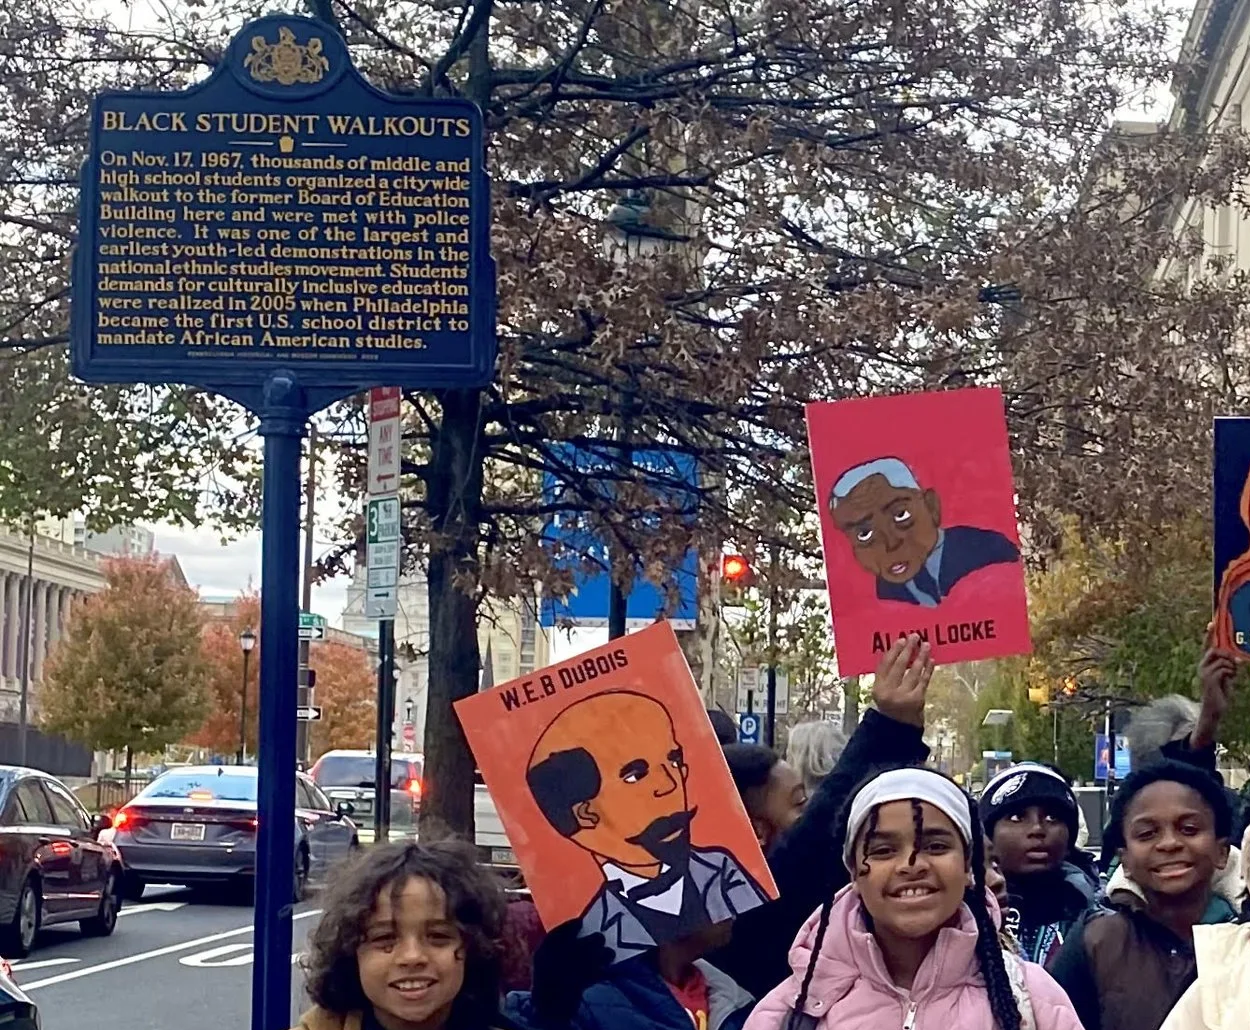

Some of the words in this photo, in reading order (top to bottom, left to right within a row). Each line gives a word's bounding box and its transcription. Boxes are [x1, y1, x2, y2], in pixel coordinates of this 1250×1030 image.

[102, 111, 188, 131] BLACK
[195, 113, 319, 134] STUDENT
[327, 115, 470, 137] WALKOUTS
[101, 151, 126, 166] On
[132, 151, 168, 167] Nov.
[251, 154, 344, 170] thousands
[348, 155, 368, 170] of
[370, 156, 431, 172] middle
[436, 157, 470, 172] and
[100, 169, 140, 188] high
[144, 170, 200, 186] school
[204, 171, 281, 187] students
[286, 173, 376, 192] organized
[379, 178, 388, 189] a
[392, 175, 470, 193] citywide
[101, 188, 169, 203] walkout
[174, 190, 194, 203] to
[197, 189, 226, 204] the
[230, 190, 293, 205] former
[298, 191, 351, 206] Board
[355, 192, 376, 206] of
[380, 193, 470, 208] Education
[100, 205, 176, 224] Building
[184, 206, 225, 221] here
[232, 207, 264, 222] and
[272, 212, 314, 222] were
[323, 209, 358, 223] met
[365, 209, 406, 224] with
[414, 210, 470, 227] police
[100, 223, 182, 239] violence.
[194, 225, 210, 239] It
[217, 229, 250, 240] was
[257, 230, 291, 241] one
[298, 227, 318, 241] of
[324, 227, 356, 242] the
[364, 228, 428, 246] largest
[436, 229, 469, 243] and
[100, 241, 169, 256] earliest
[172, 242, 265, 261] youth-led
[270, 244, 412, 260] demonstrations
[418, 247, 435, 260] in
[439, 247, 470, 261] the
[98, 259, 170, 274] national
[172, 260, 228, 275] ethnic
[230, 261, 292, 276] studies
[295, 263, 386, 277] movement.
[98, 277, 174, 292] demands
[178, 278, 205, 292] for
[208, 279, 300, 296] culturally
[303, 280, 378, 294] inclusive
[382, 281, 469, 295] education
[98, 299, 142, 309] were
[148, 296, 224, 311] realized
[229, 298, 246, 311] in
[251, 297, 296, 312] 2005
[301, 298, 348, 312] when
[354, 299, 468, 317] Philadelphia
[98, 312, 169, 328] became
[174, 313, 204, 328] the
[210, 314, 253, 329] first
[260, 314, 294, 329] U.S.
[302, 315, 362, 330] school
[368, 316, 442, 331] district
[448, 318, 469, 331] to
[98, 330, 175, 345] mandate
[180, 331, 254, 346] African
[260, 332, 350, 347] American
[356, 333, 427, 348] studies.
[370, 507, 377, 537] 3
[935, 619, 997, 646] LOCKE
[1235, 631, 1247, 645] G.
[499, 675, 556, 712] W.E.B
